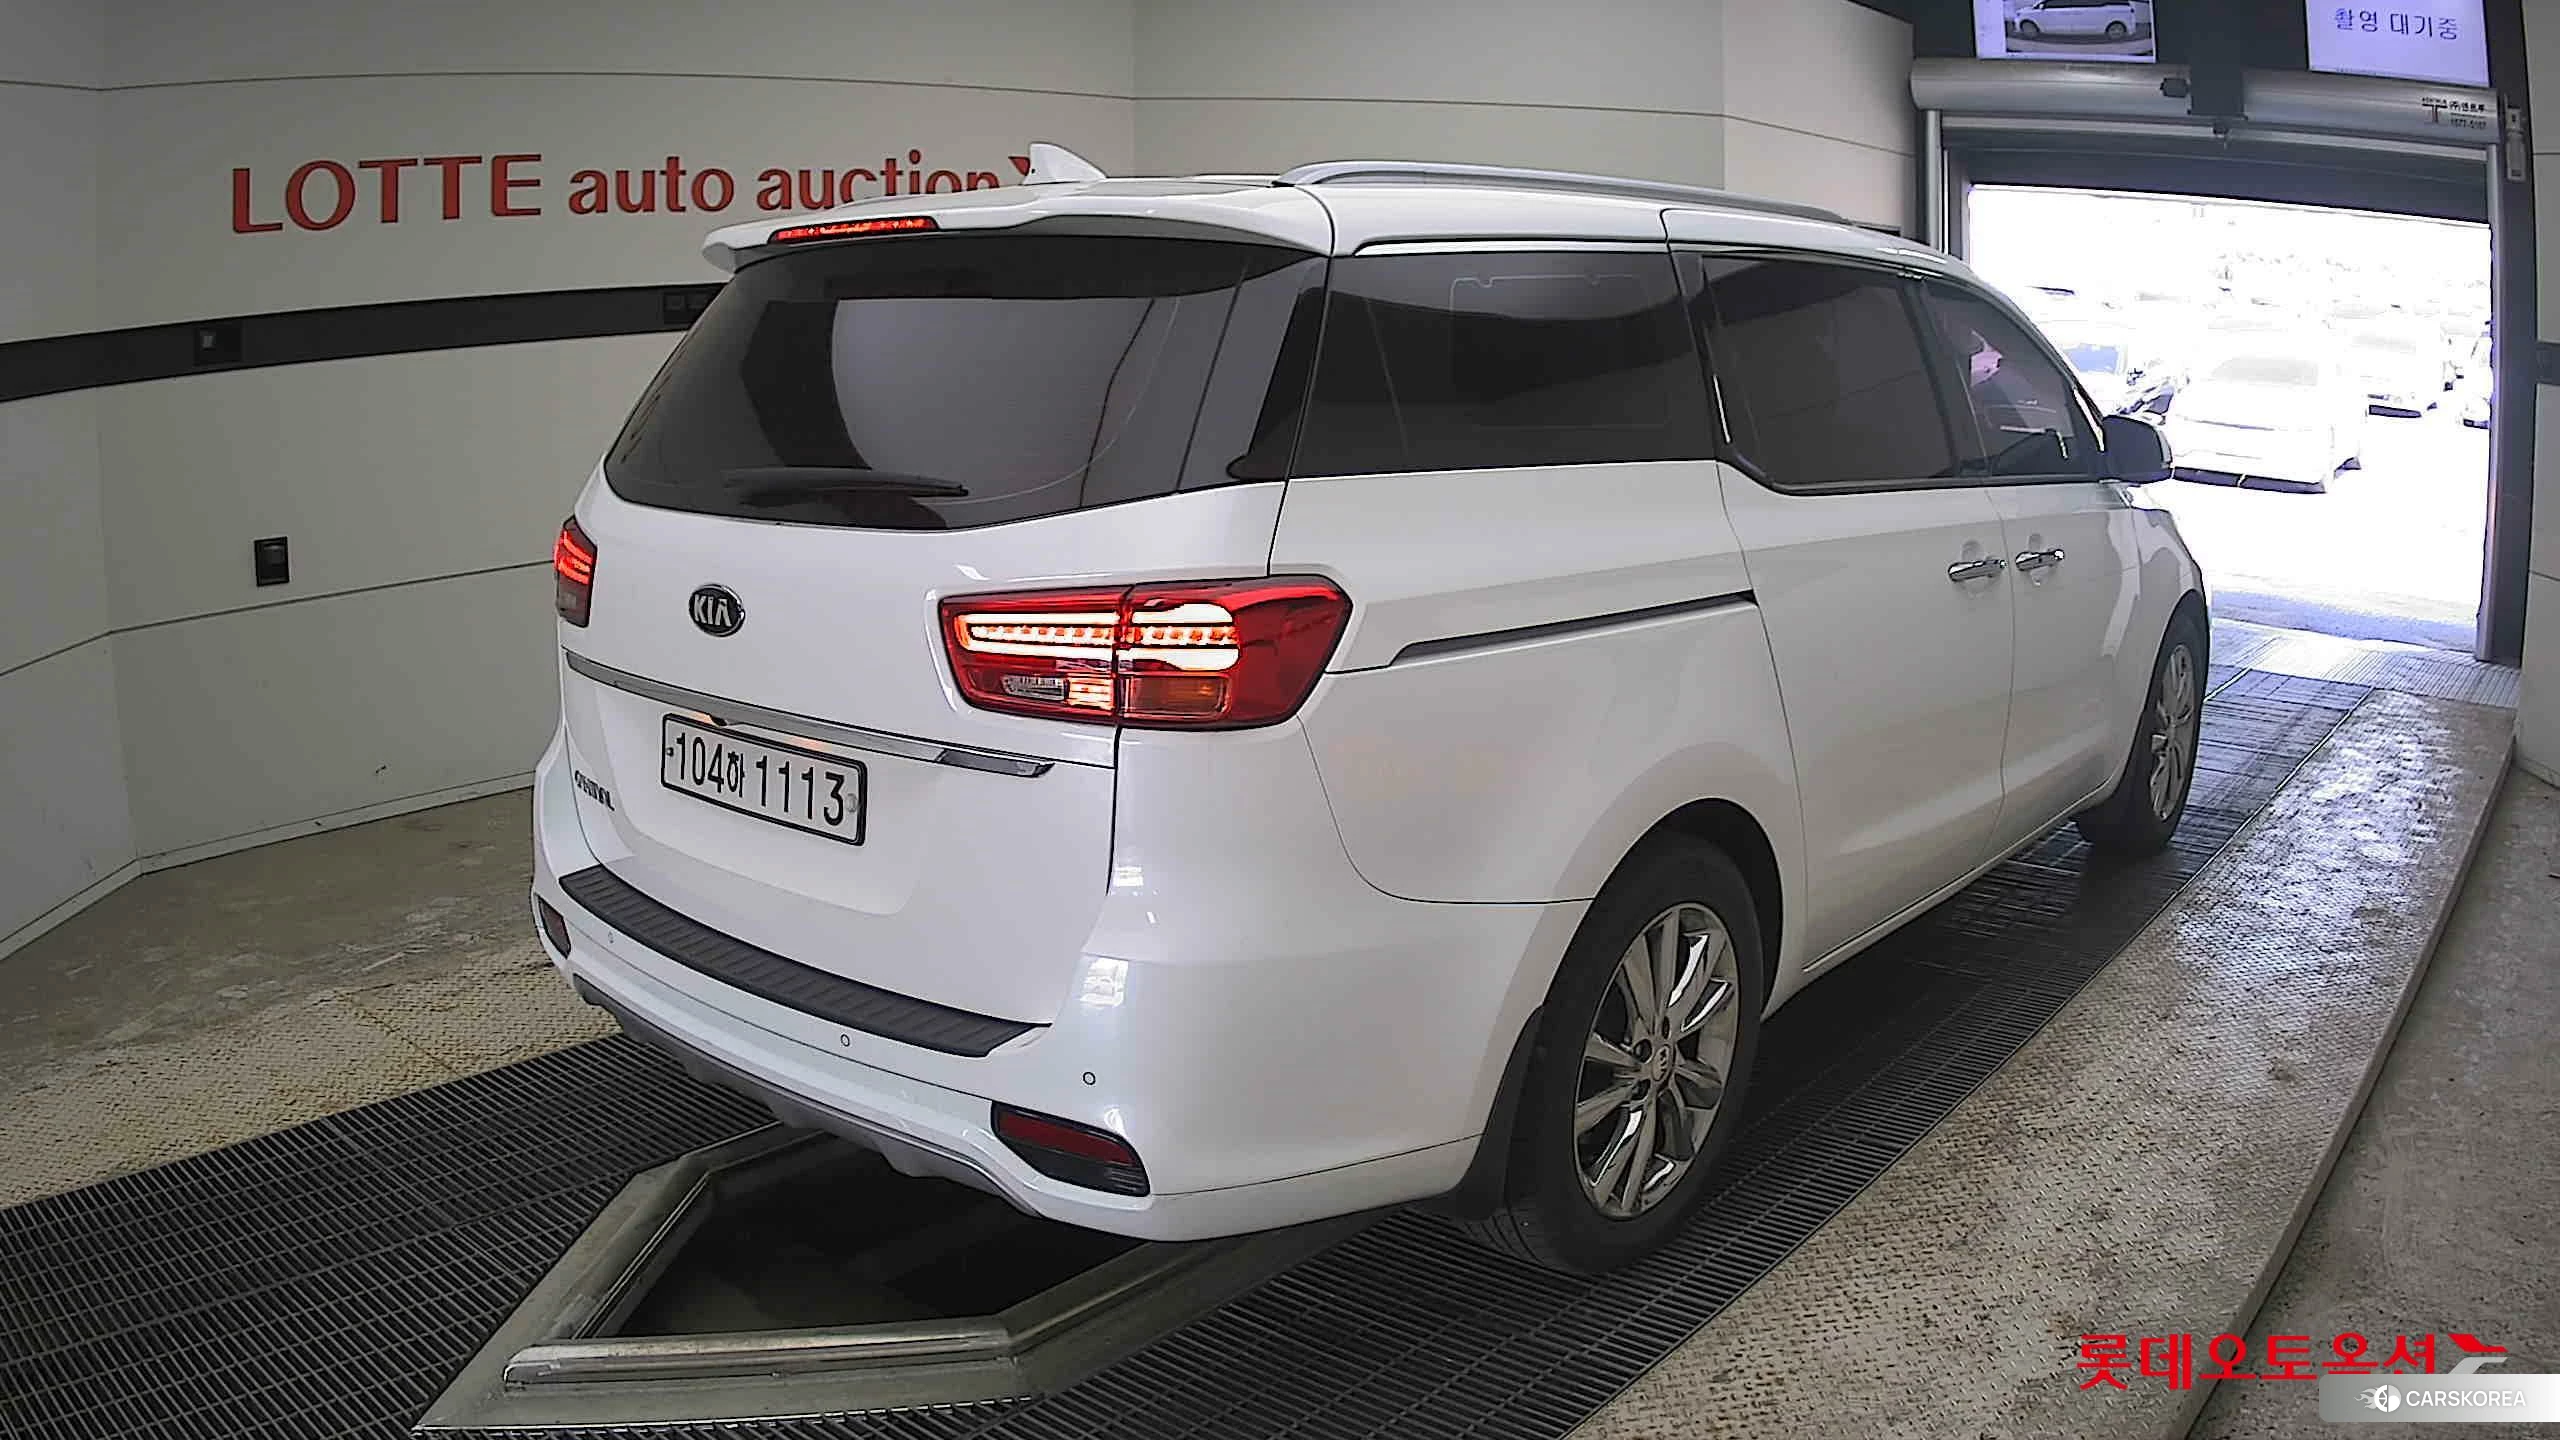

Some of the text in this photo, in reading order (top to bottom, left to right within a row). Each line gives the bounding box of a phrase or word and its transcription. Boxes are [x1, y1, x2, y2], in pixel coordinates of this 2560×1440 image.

[2335, 8, 2457, 40] 촬영 대기중
[232, 153, 542, 234] LOTTE
[567, 155, 735, 214] auto
[693, 593, 733, 628] KIA
[676, 732, 847, 826] 104하 1113
